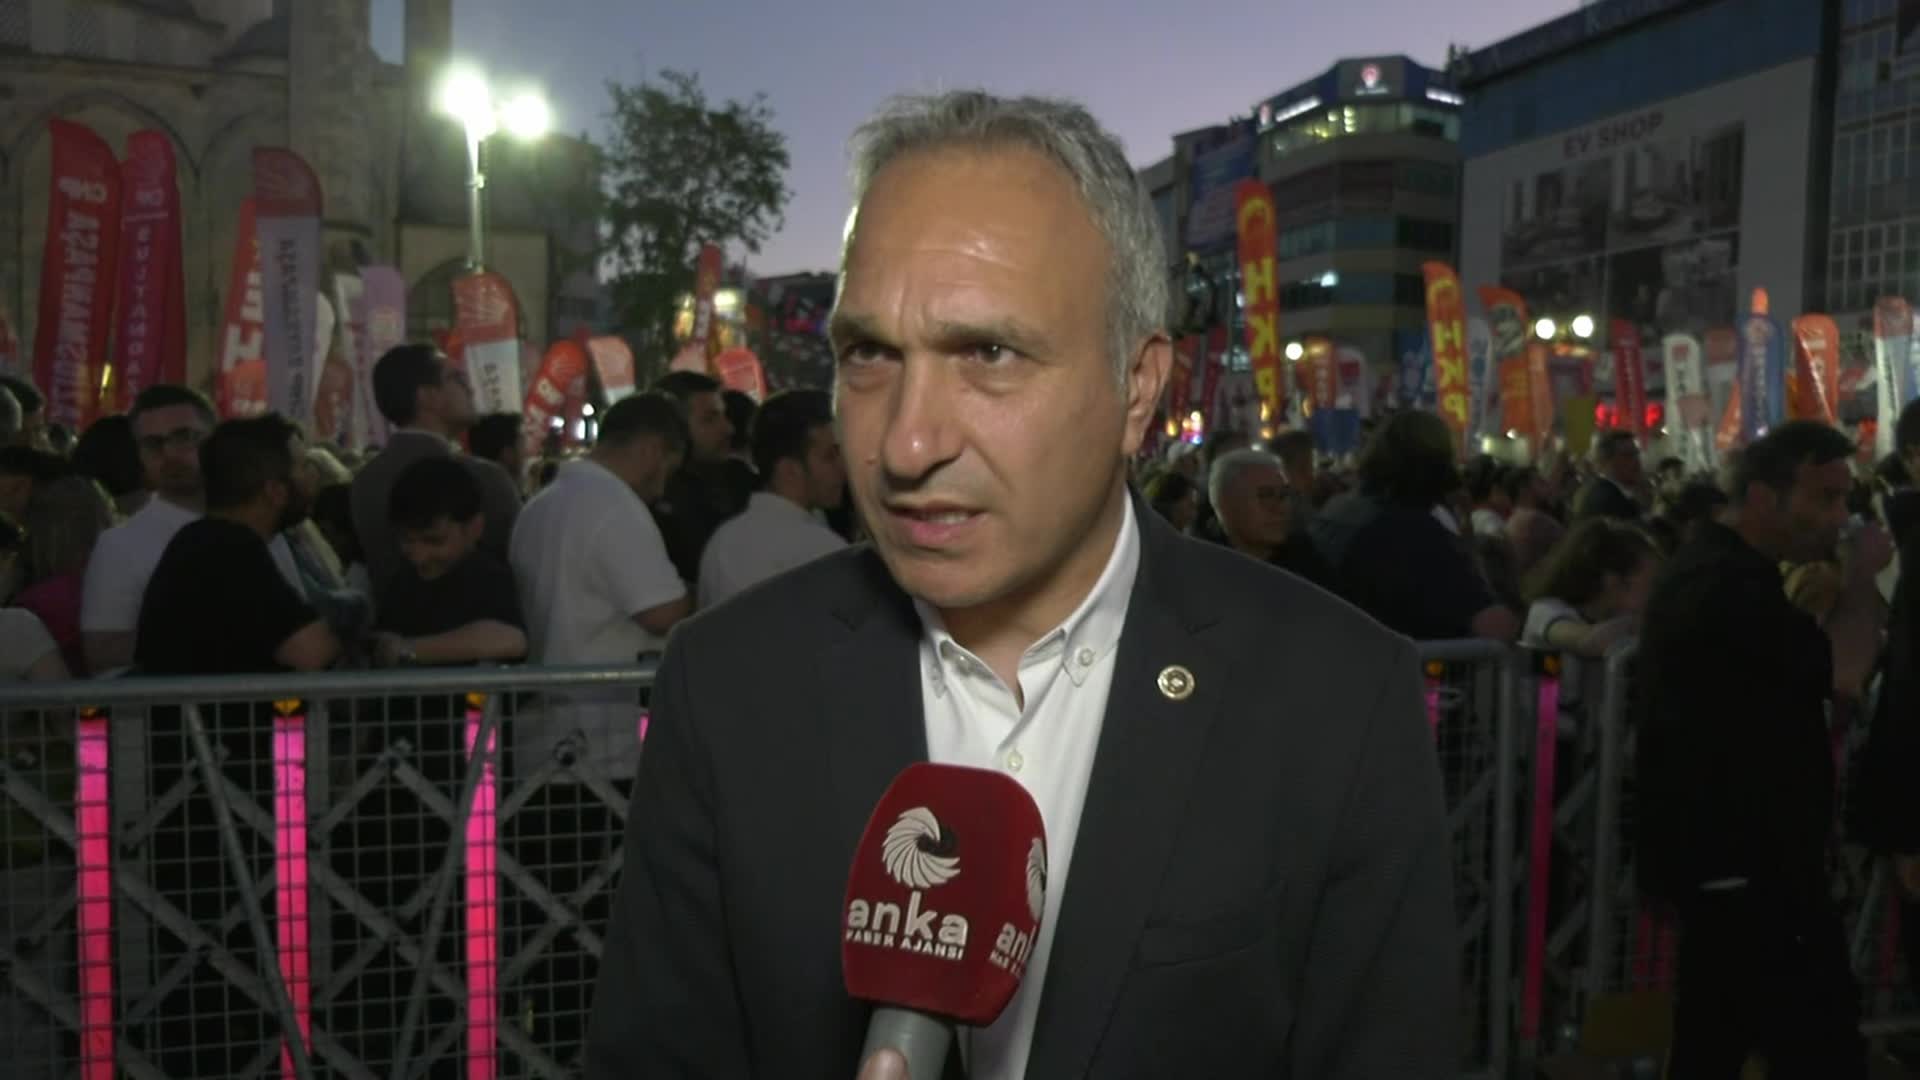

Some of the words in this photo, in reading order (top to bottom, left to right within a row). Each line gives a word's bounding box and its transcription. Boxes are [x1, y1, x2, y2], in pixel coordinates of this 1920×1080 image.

[1563, 132, 1593, 158] EV
[1597, 112, 1665, 147] SHOP
[847, 889, 969, 947] anka
[901, 936, 964, 961] AJANSI
